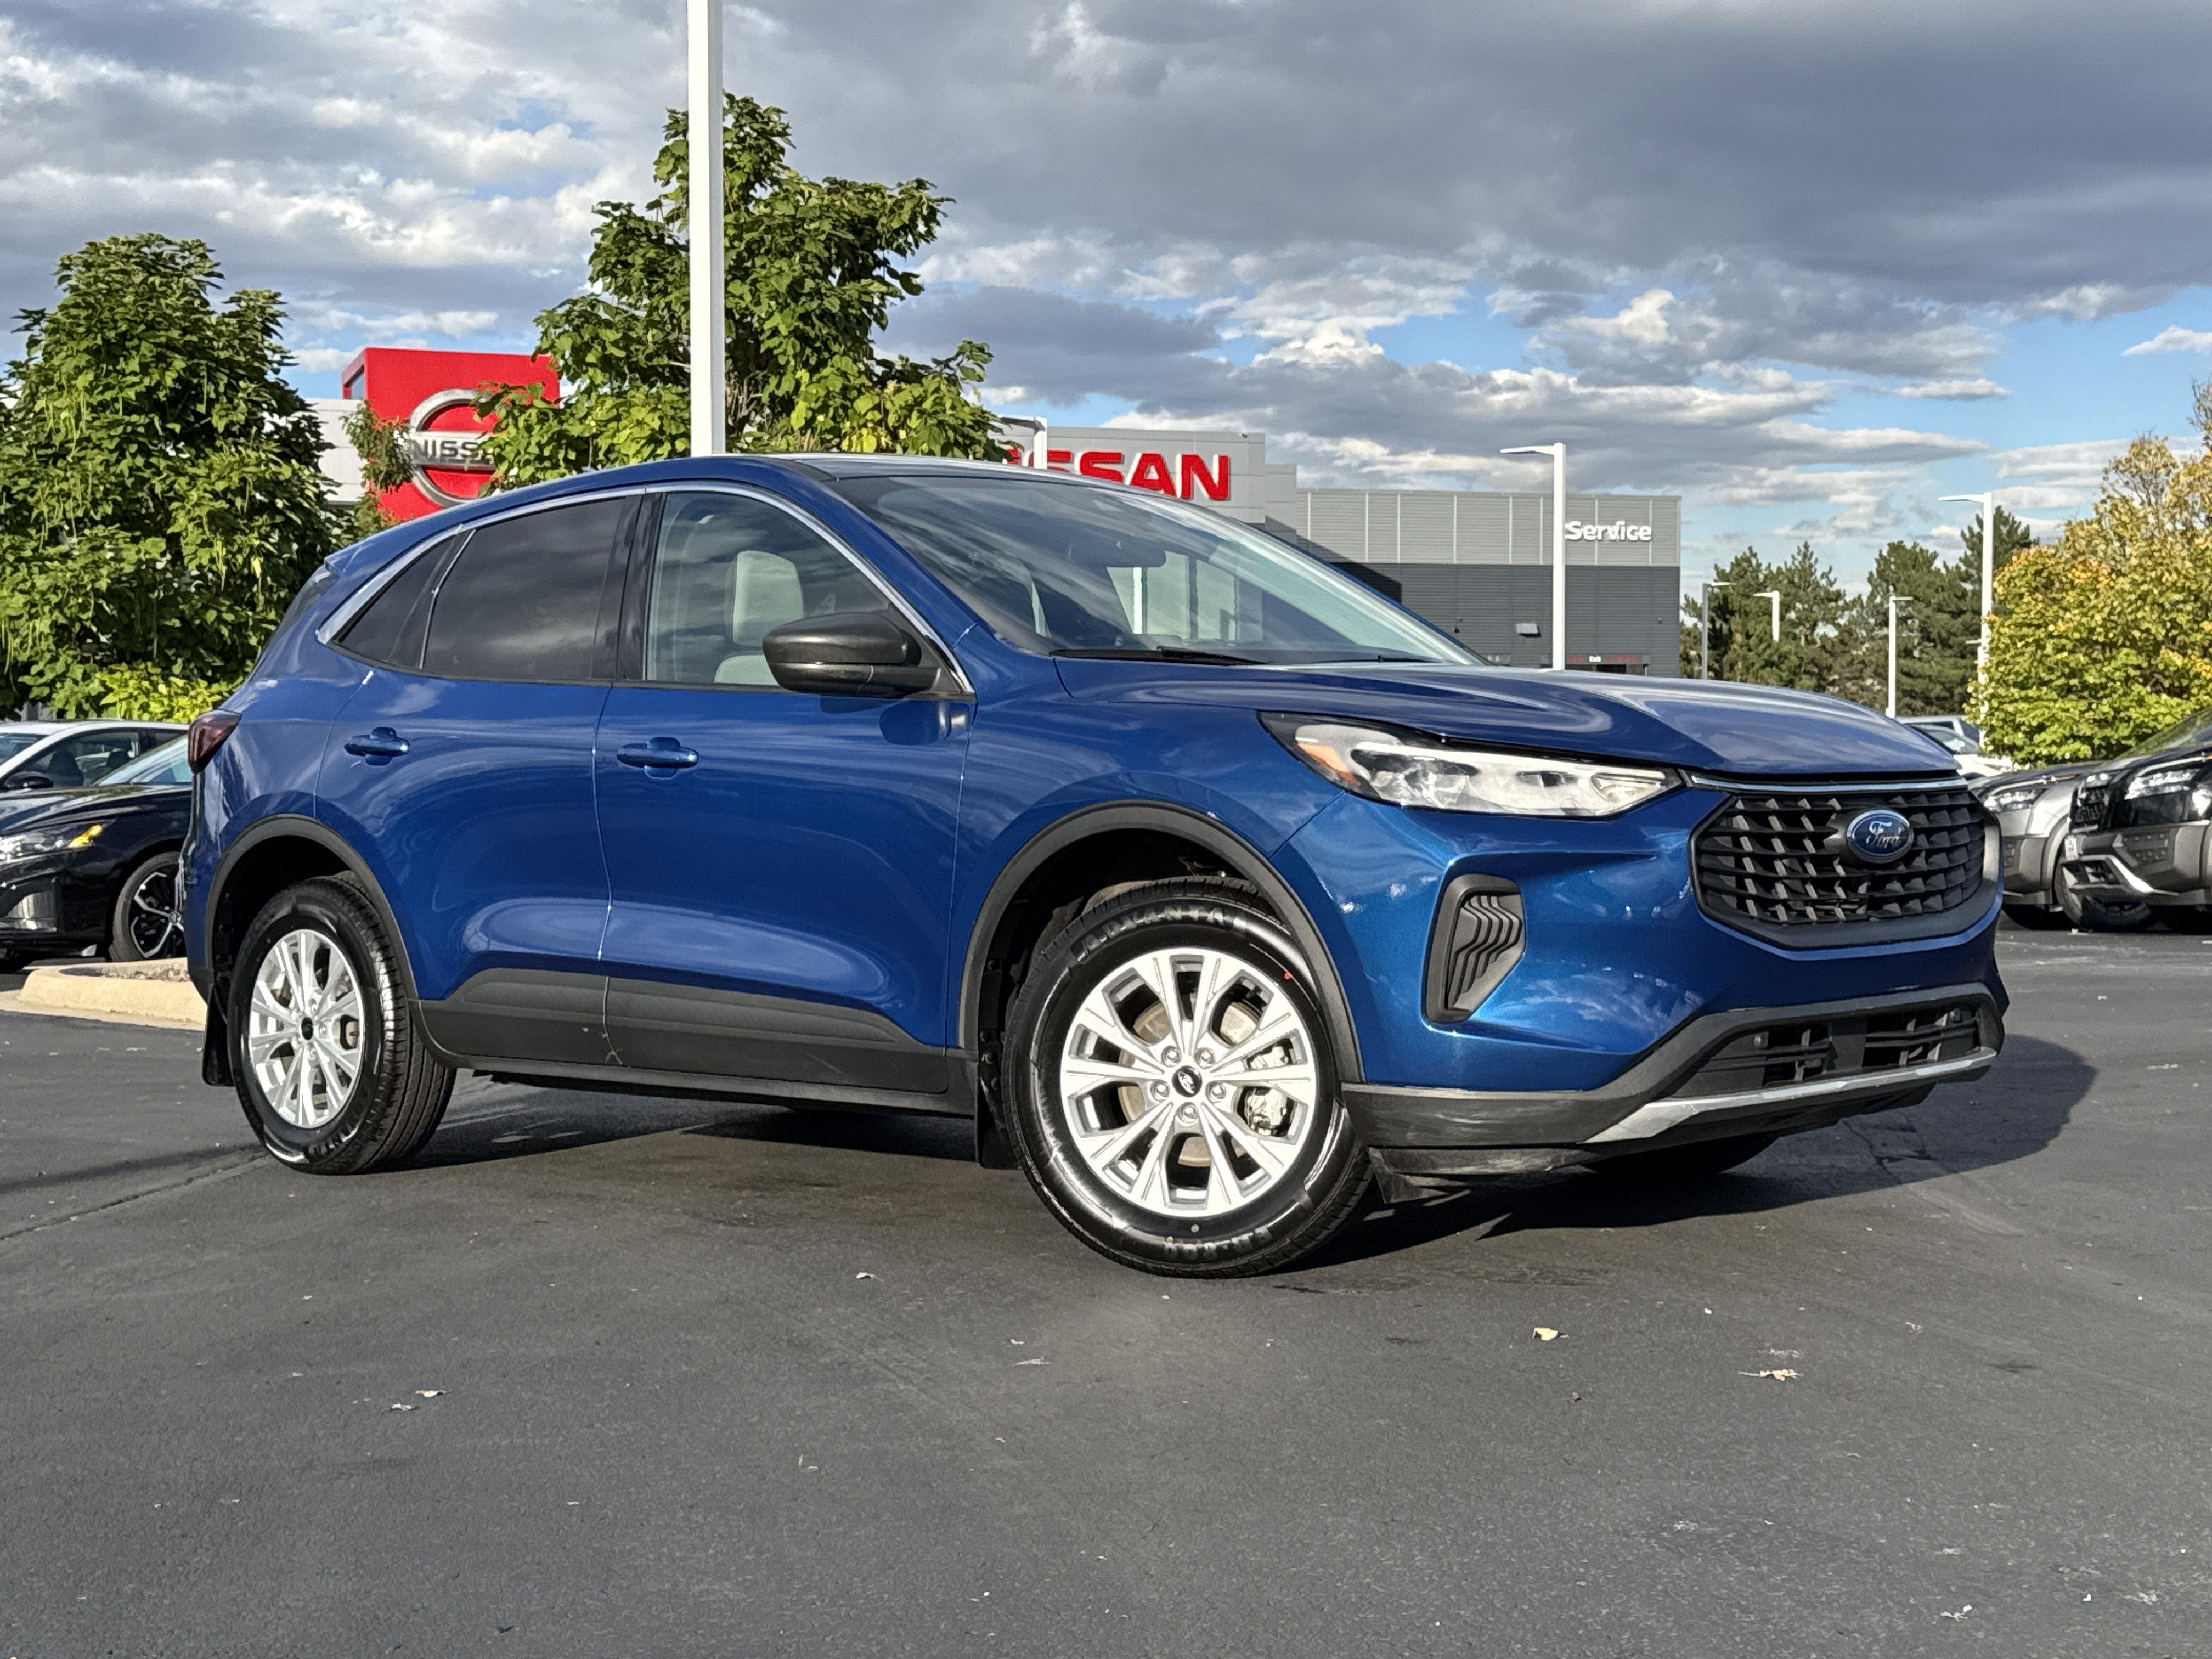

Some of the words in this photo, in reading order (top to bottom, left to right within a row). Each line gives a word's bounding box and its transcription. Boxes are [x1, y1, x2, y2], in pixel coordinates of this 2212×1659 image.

[410, 439, 481, 459] NISS
[1001, 447, 1231, 501] SAN
[1564, 521, 1652, 541] Service
[1865, 821, 1905, 849] Ford
